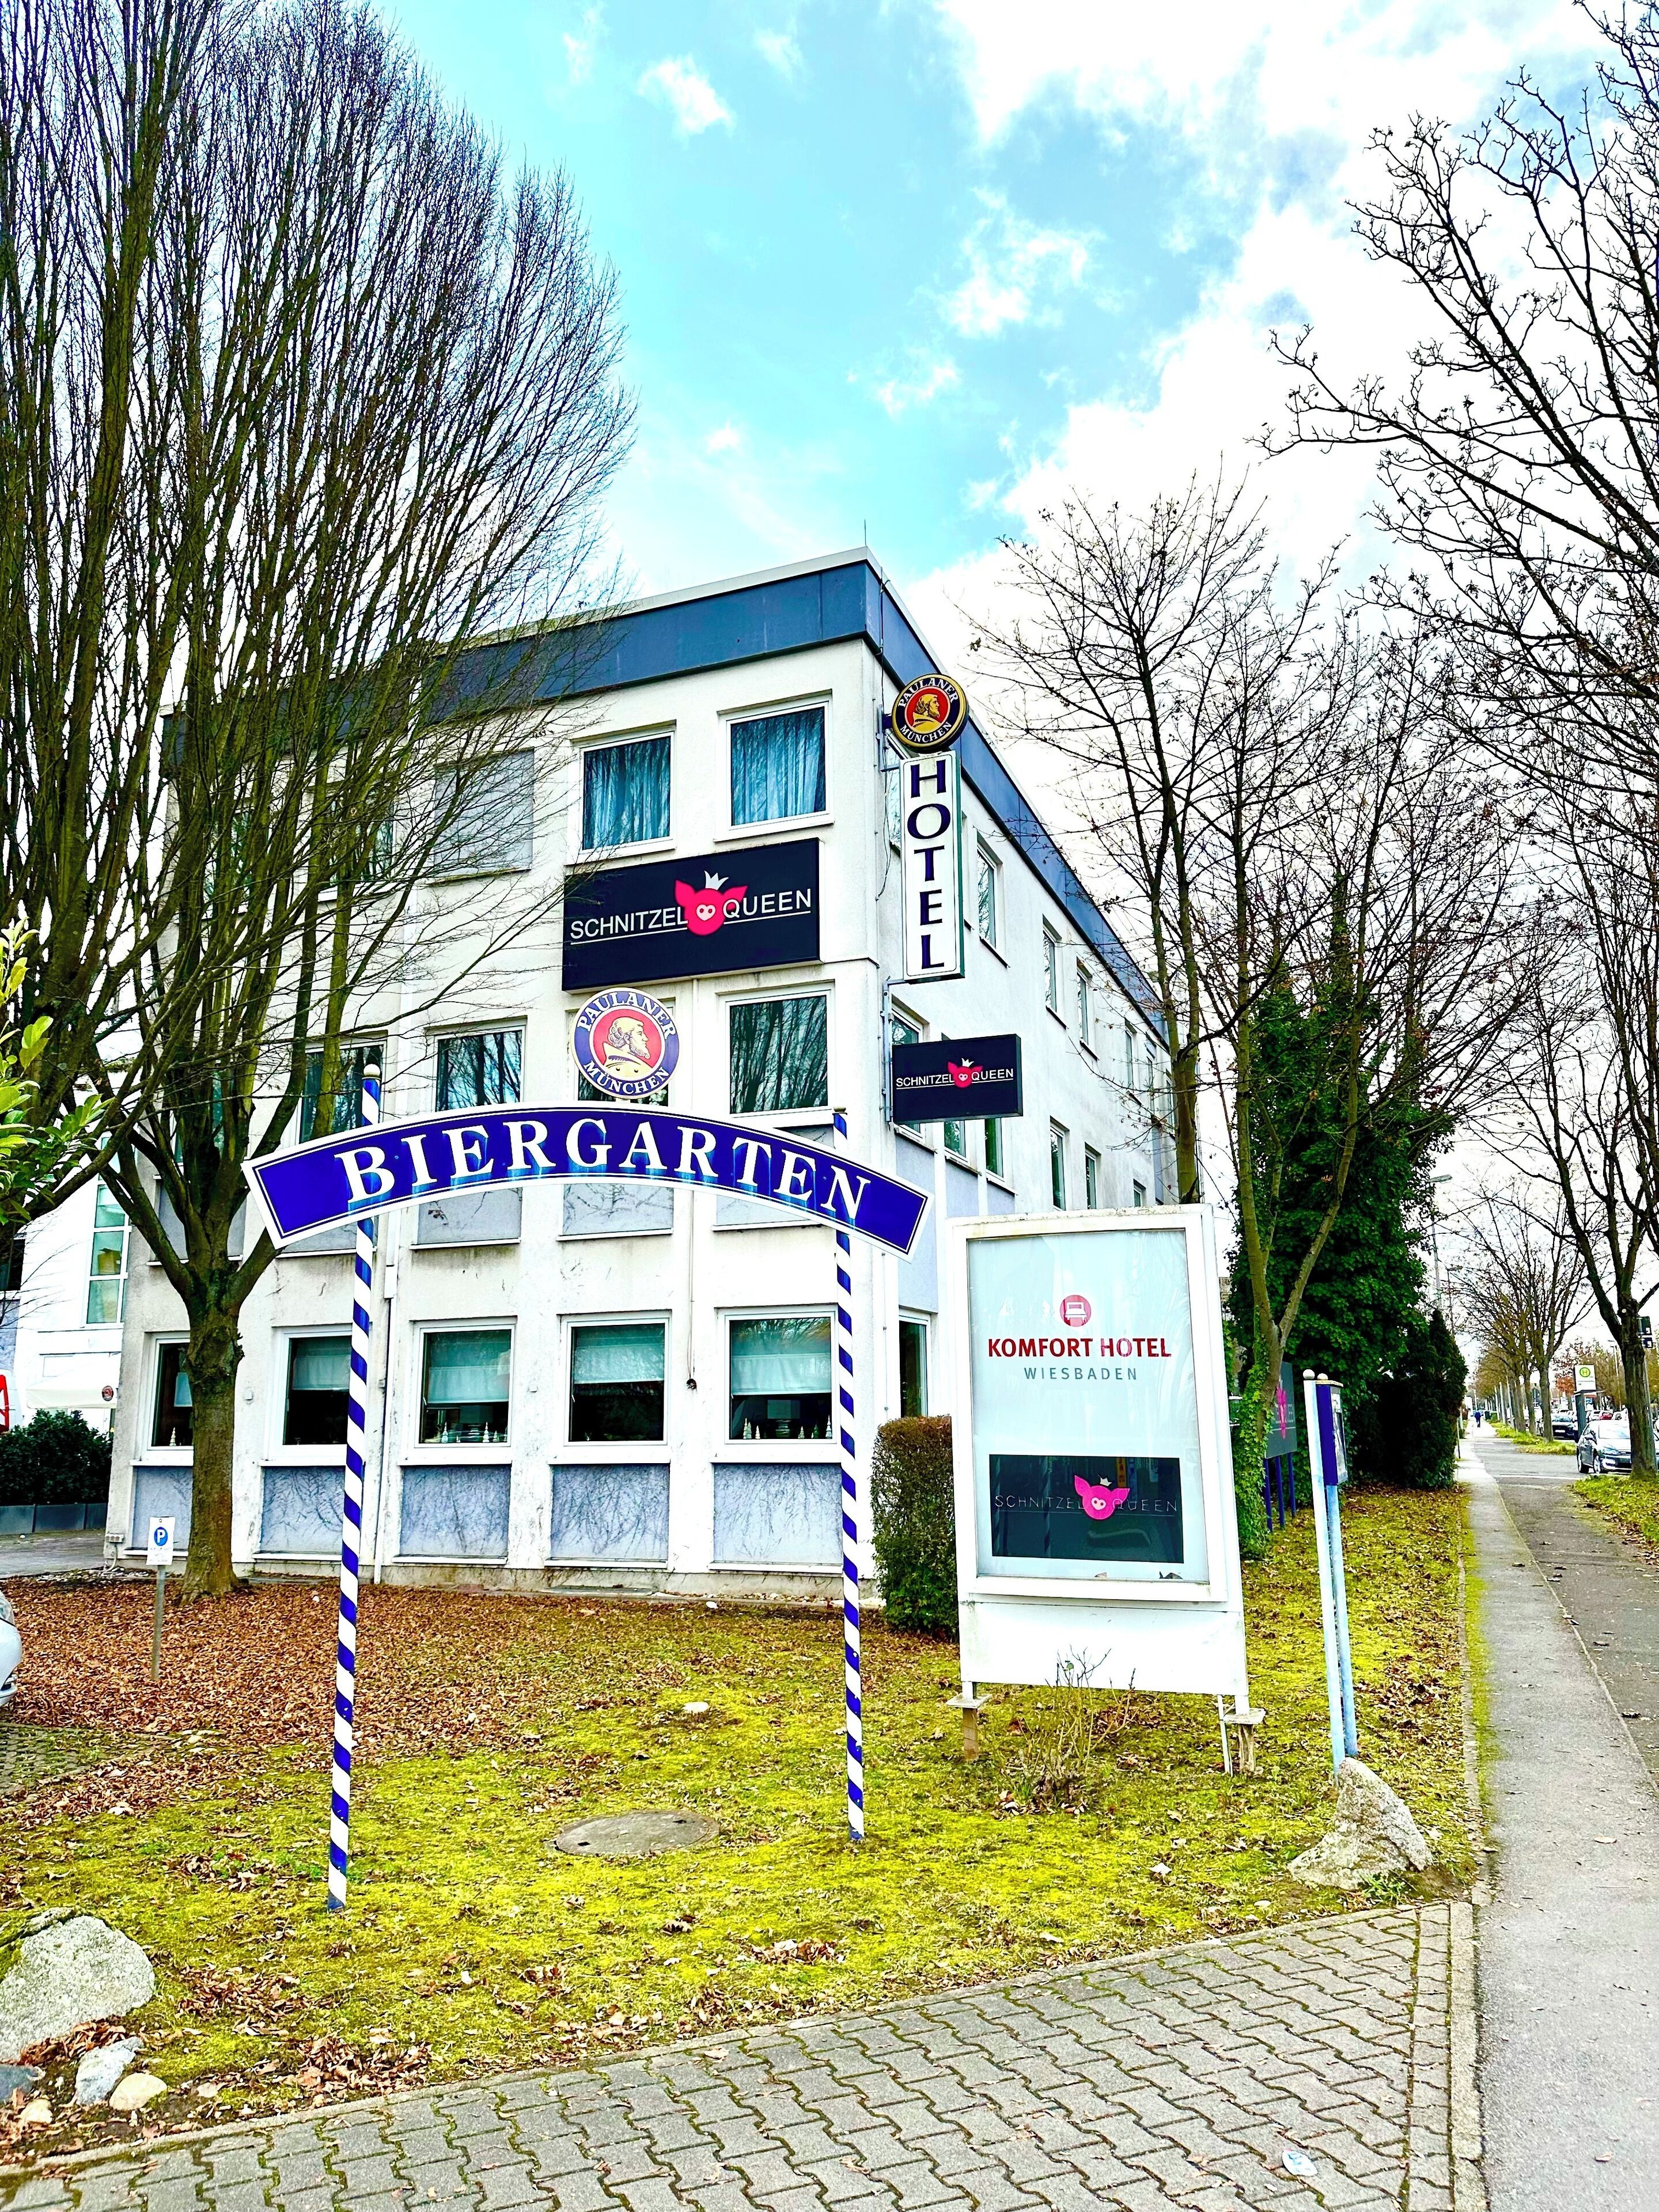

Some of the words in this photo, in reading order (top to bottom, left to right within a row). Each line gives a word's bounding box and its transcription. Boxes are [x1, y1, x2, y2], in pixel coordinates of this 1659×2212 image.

[897, 677, 959, 708] PAULANER
[900, 721, 952, 743] MÜNCHEN
[907, 759, 951, 969] HOTEL
[570, 906, 688, 939] SCHNITZEL
[722, 888, 812, 918] QUEEN
[577, 992, 676, 1039] PAULANER
[584, 1060, 669, 1094] MÜNCHEN
[896, 1074, 955, 1087] SCHNITZEL
[971, 1068, 1014, 1081] QUEEN
[334, 1118, 872, 1221] BIERGARTEN
[988, 1338, 1093, 1357] KOMFORT
[1100, 1338, 1172, 1357] HOTEL
[1024, 1368, 1137, 1380] WIESBADEN
[995, 1495, 1085, 1510] SCHNITZEL
[1112, 1498, 1177, 1512] QUEEN
[157, 1529, 166, 1543] P
